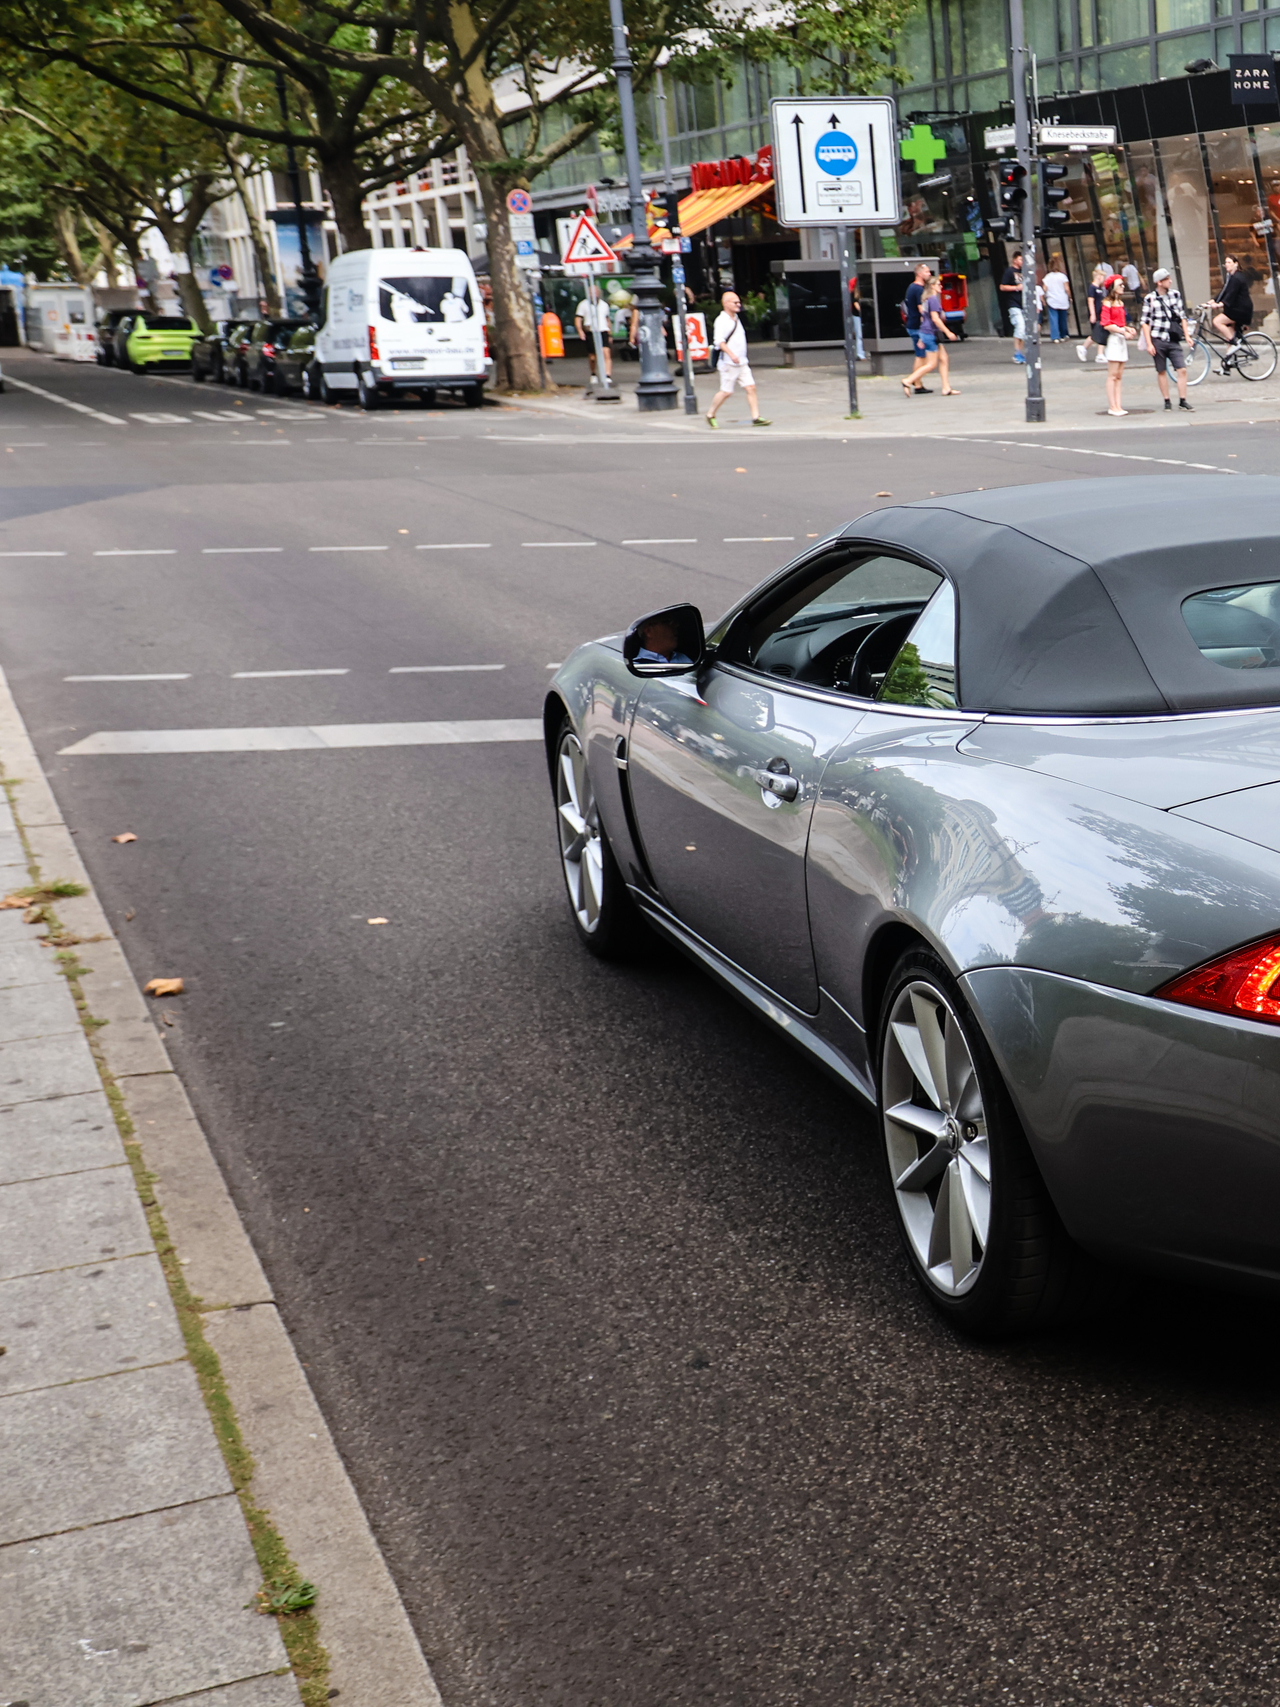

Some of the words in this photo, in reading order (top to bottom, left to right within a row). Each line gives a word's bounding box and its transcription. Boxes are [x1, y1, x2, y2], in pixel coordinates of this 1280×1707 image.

[1235, 69, 1269, 78] ZARA
[1233, 80, 1270, 90] HOME
[1047, 129, 1109, 140] Knesebeckstraße
